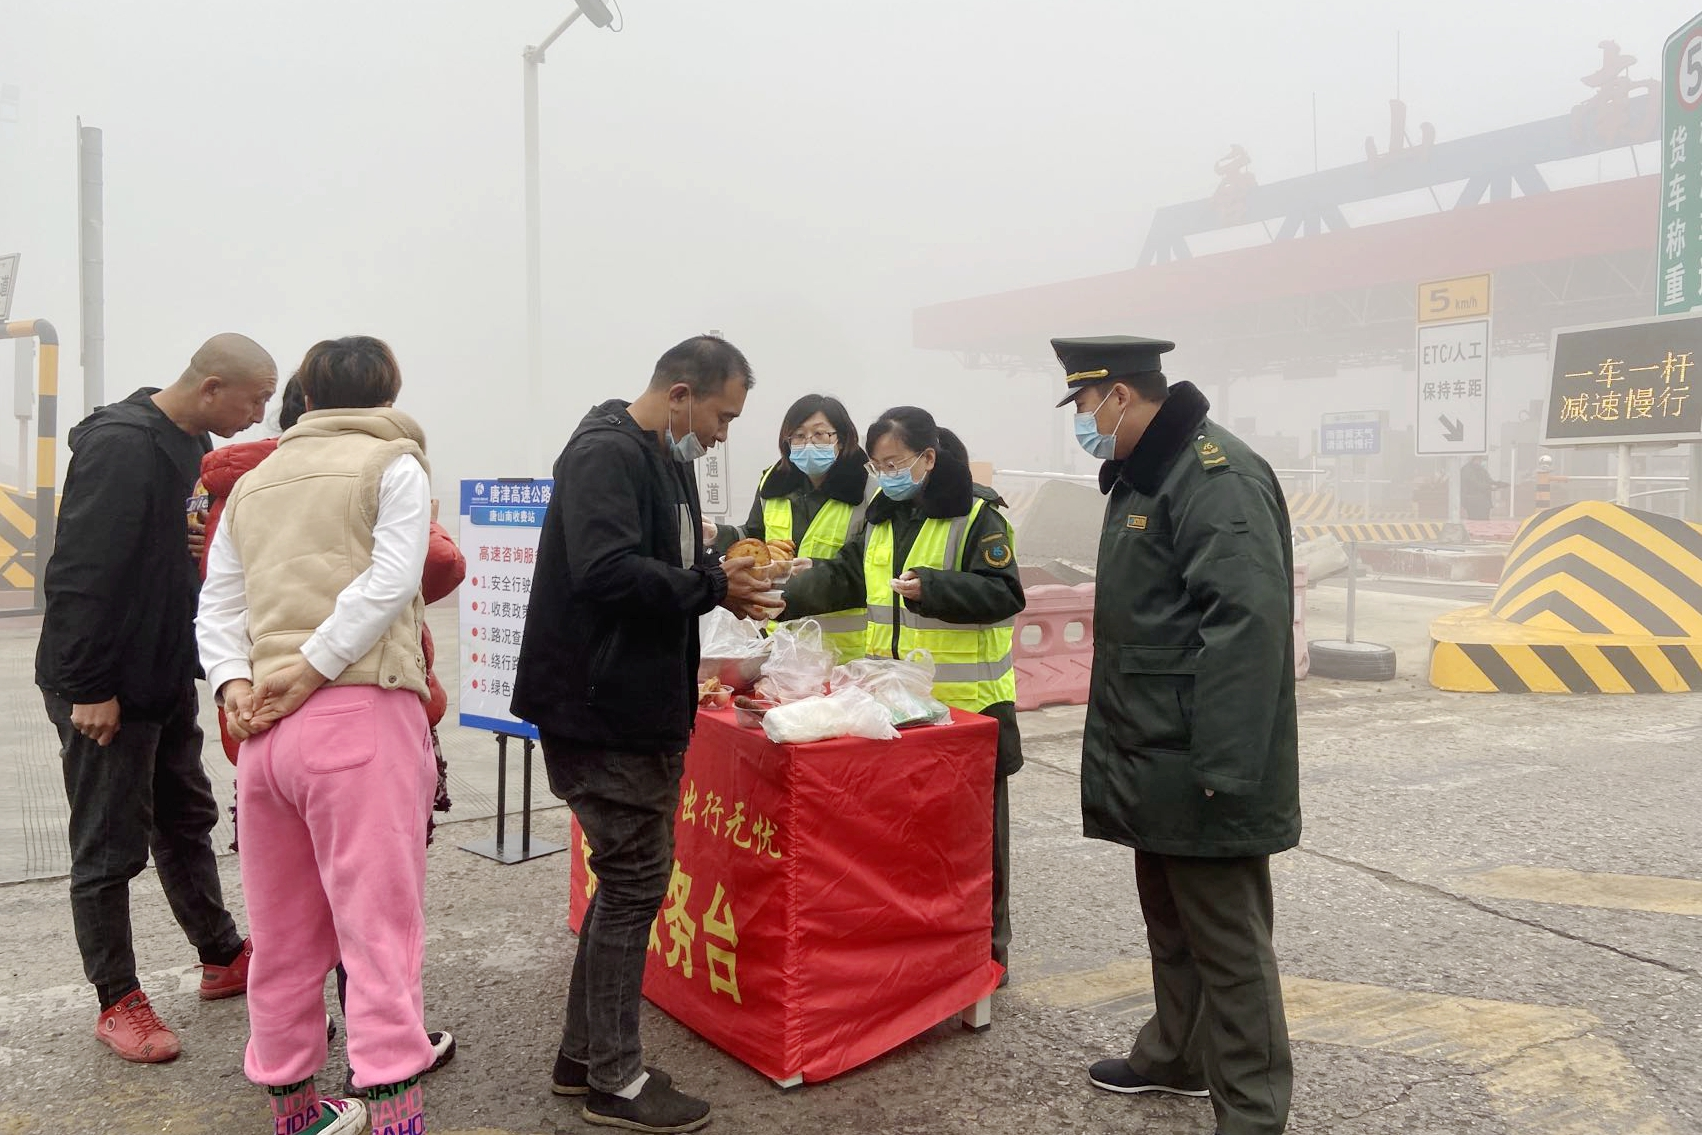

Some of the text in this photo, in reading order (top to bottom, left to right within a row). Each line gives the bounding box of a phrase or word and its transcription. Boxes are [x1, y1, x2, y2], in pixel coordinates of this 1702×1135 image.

[1664, 125, 1688, 307] 货车称重
[1429, 288, 1478, 313] 5 km/h
[1423, 341, 1482, 365] ETC/人工
[1565, 351, 1695, 389] 一车一杆
[1422, 378, 1482, 401] 保持车距
[1560, 386, 1690, 423] 减速慢行
[706, 442, 719, 505] 通道
[489, 484, 551, 504] 唐津高速公路
[489, 509, 536, 524] 唐山南收费站
[480, 627, 524, 646] 3.路况查
[480, 678, 515, 698] 5.绿色
[681, 780, 782, 859] 出行无忧
[648, 859, 742, 1004] 务台
